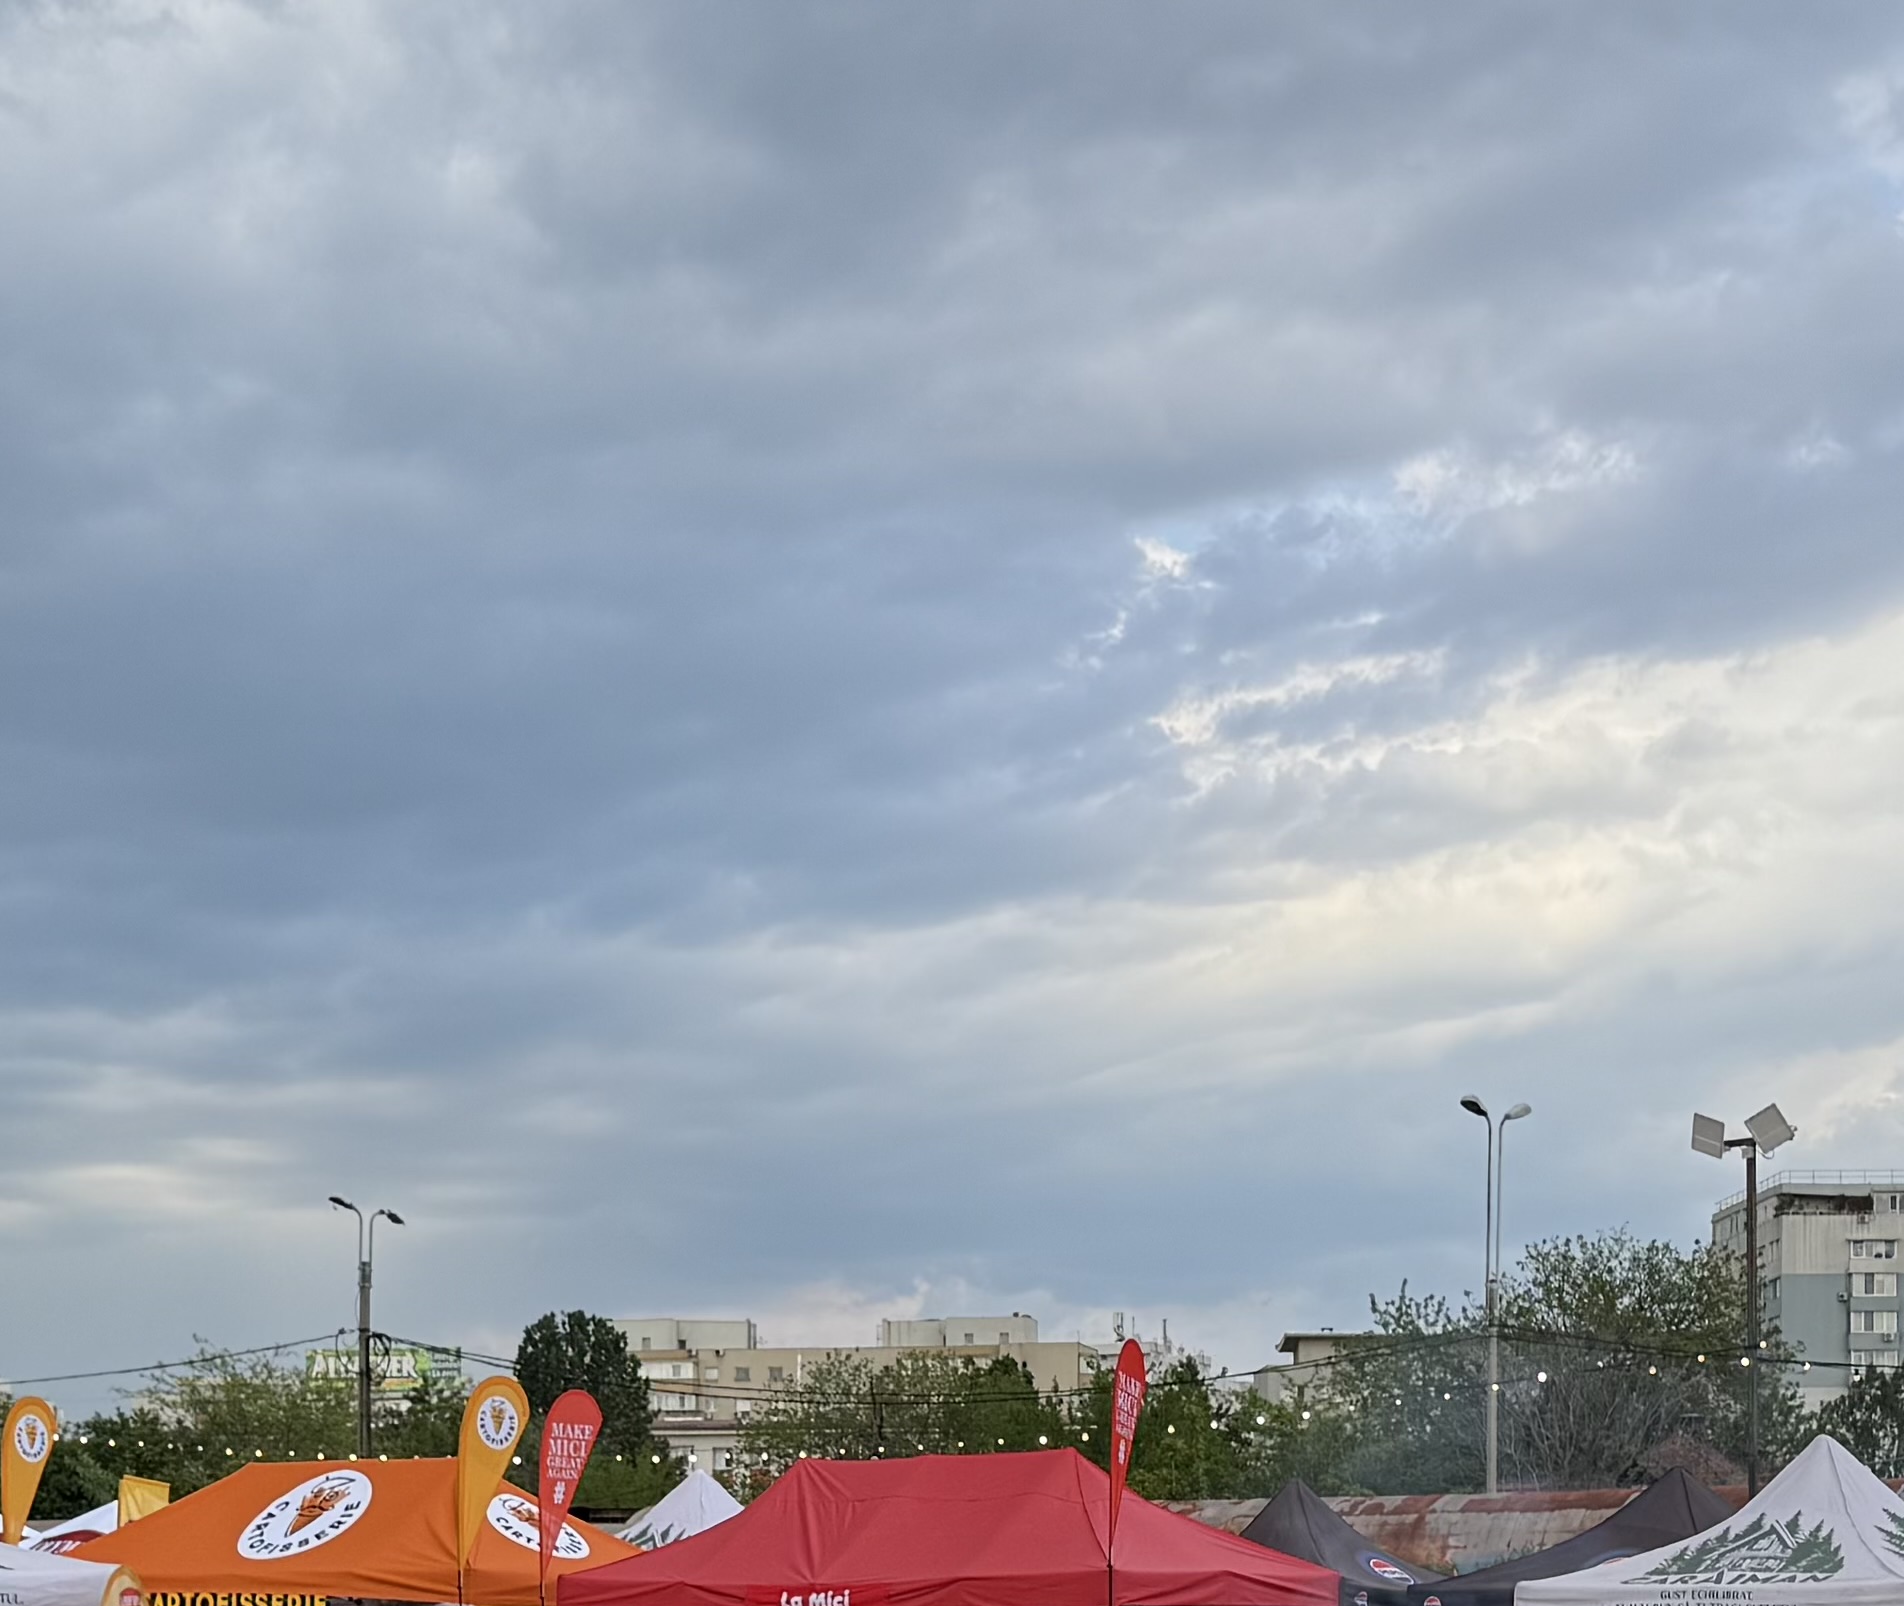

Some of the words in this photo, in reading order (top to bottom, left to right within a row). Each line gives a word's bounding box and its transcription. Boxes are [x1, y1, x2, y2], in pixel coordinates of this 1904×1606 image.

[551, 1422, 594, 1440] MAKE
[548, 1439, 589, 1457] MICI
[547, 1456, 585, 1471] GREAT
[248, 1500, 362, 1554] CARTOFISSERIE
[1660, 1590, 1686, 1600] GUST
